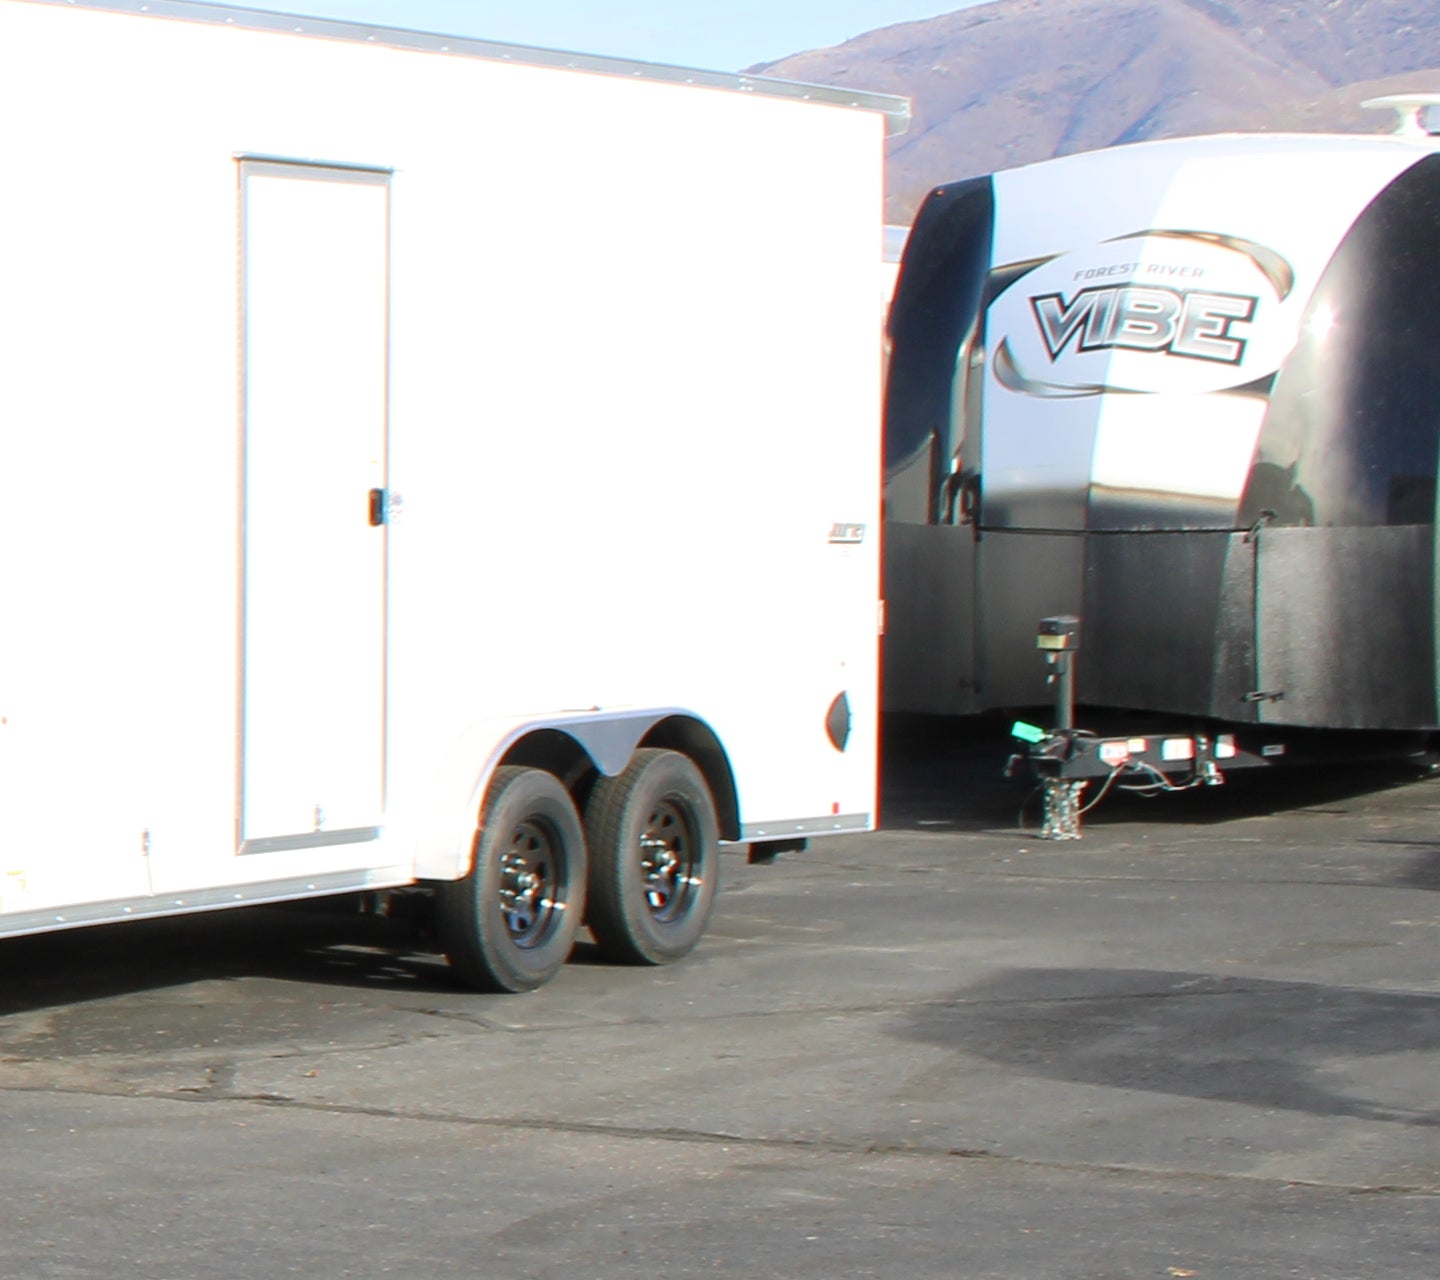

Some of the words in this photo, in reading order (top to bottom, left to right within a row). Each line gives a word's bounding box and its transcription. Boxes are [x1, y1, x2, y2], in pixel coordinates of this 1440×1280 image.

[1073, 263, 1140, 282] FOREST
[1146, 263, 1206, 278] RIVER
[1028, 282, 1261, 367] VIBE
